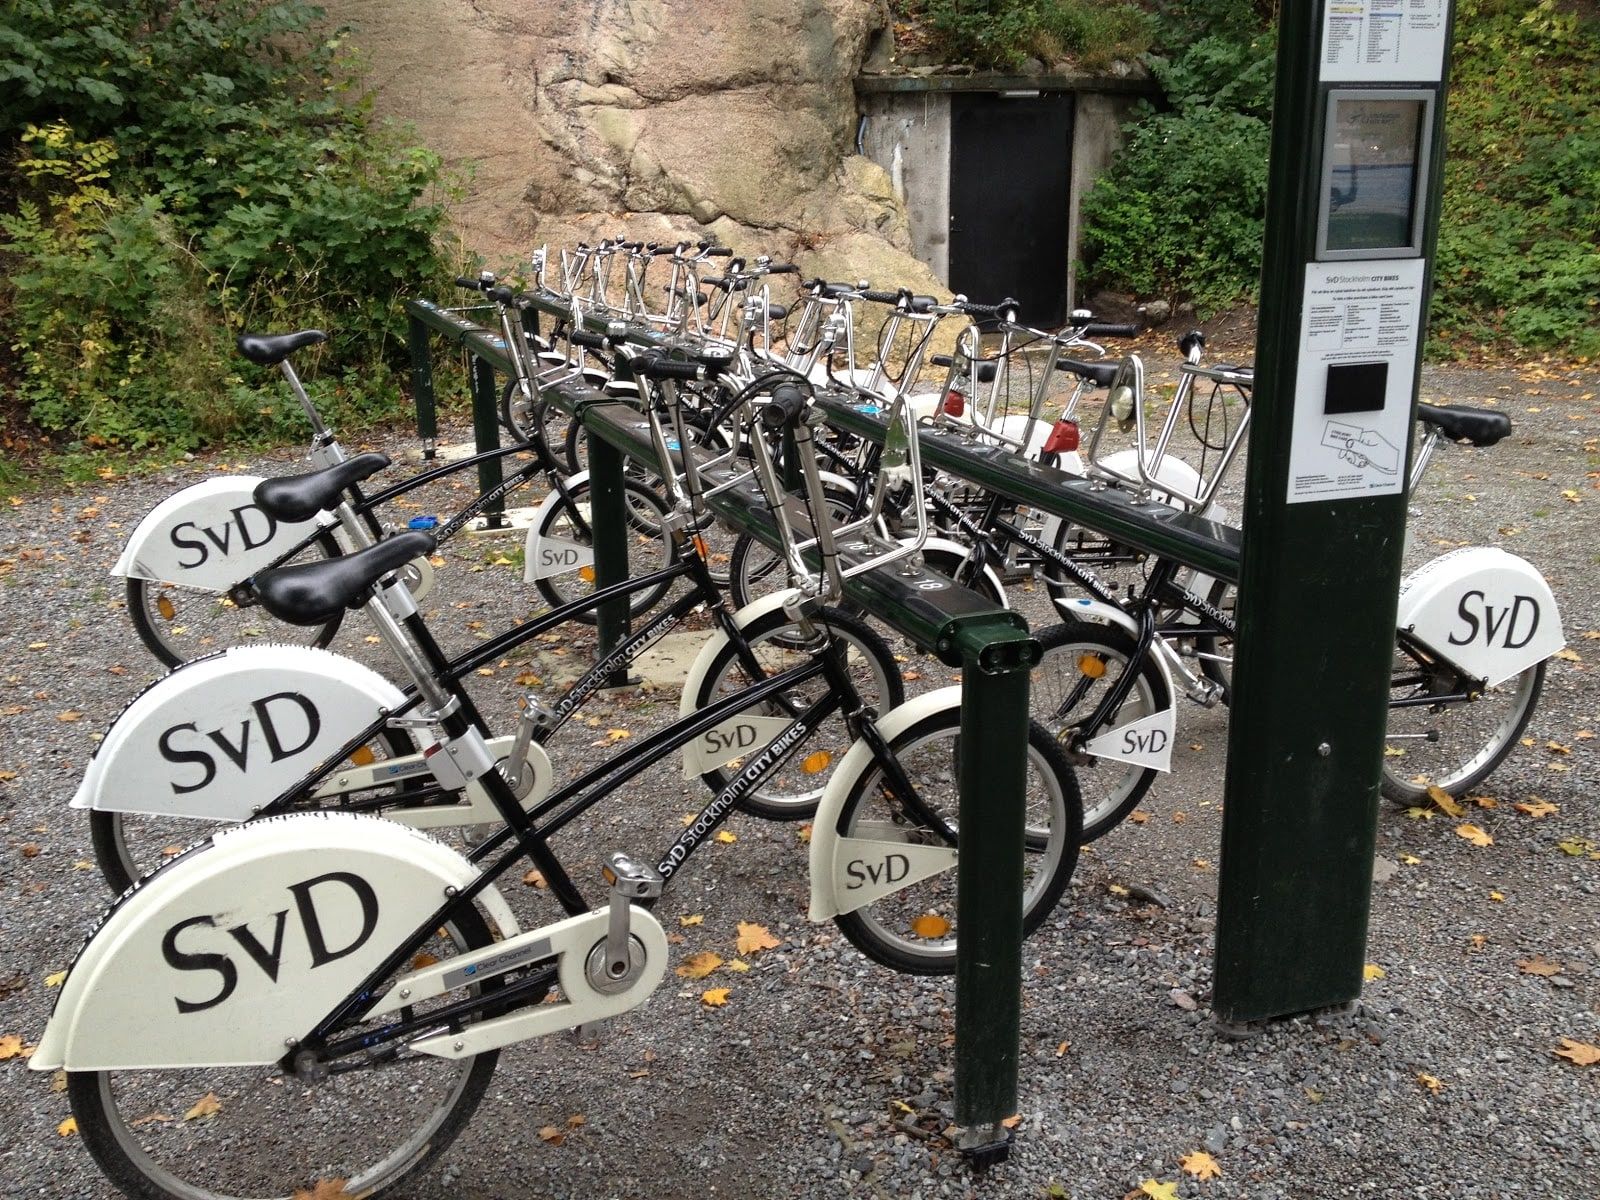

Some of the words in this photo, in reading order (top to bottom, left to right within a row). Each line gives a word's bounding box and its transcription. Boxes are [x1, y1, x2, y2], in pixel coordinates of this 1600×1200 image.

[451, 498, 490, 532] Stockholm
[489, 484, 504, 501] CITY
[503, 474, 524, 491] BIKES
[170, 503, 278, 569] SvD
[542, 550, 578, 566] SvD
[1018, 529, 1036, 547] SvD
[1036, 540, 1078, 573] Stockholm
[1077, 568, 1094, 584] CITY
[1092, 579, 1112, 600] BIKES
[1448, 590, 1540, 649] SvD
[571, 650, 626, 701] Stockholm
[624, 632, 648, 658] CITY
[646, 614, 676, 640] BIKES
[158, 692, 320, 794] SvD
[705, 724, 757, 754] SvD
[1122, 729, 1167, 754] SvD
[658, 842, 688, 878] SvD
[684, 778, 748, 846] Stockholm
[746, 751, 773, 780] CITY
[772, 722, 807, 756] BIKES
[846, 854, 910, 890] SvD
[162, 870, 379, 1014] SvD
[476, 956, 498, 972] Clear
[498, 946, 532, 965] Channel
